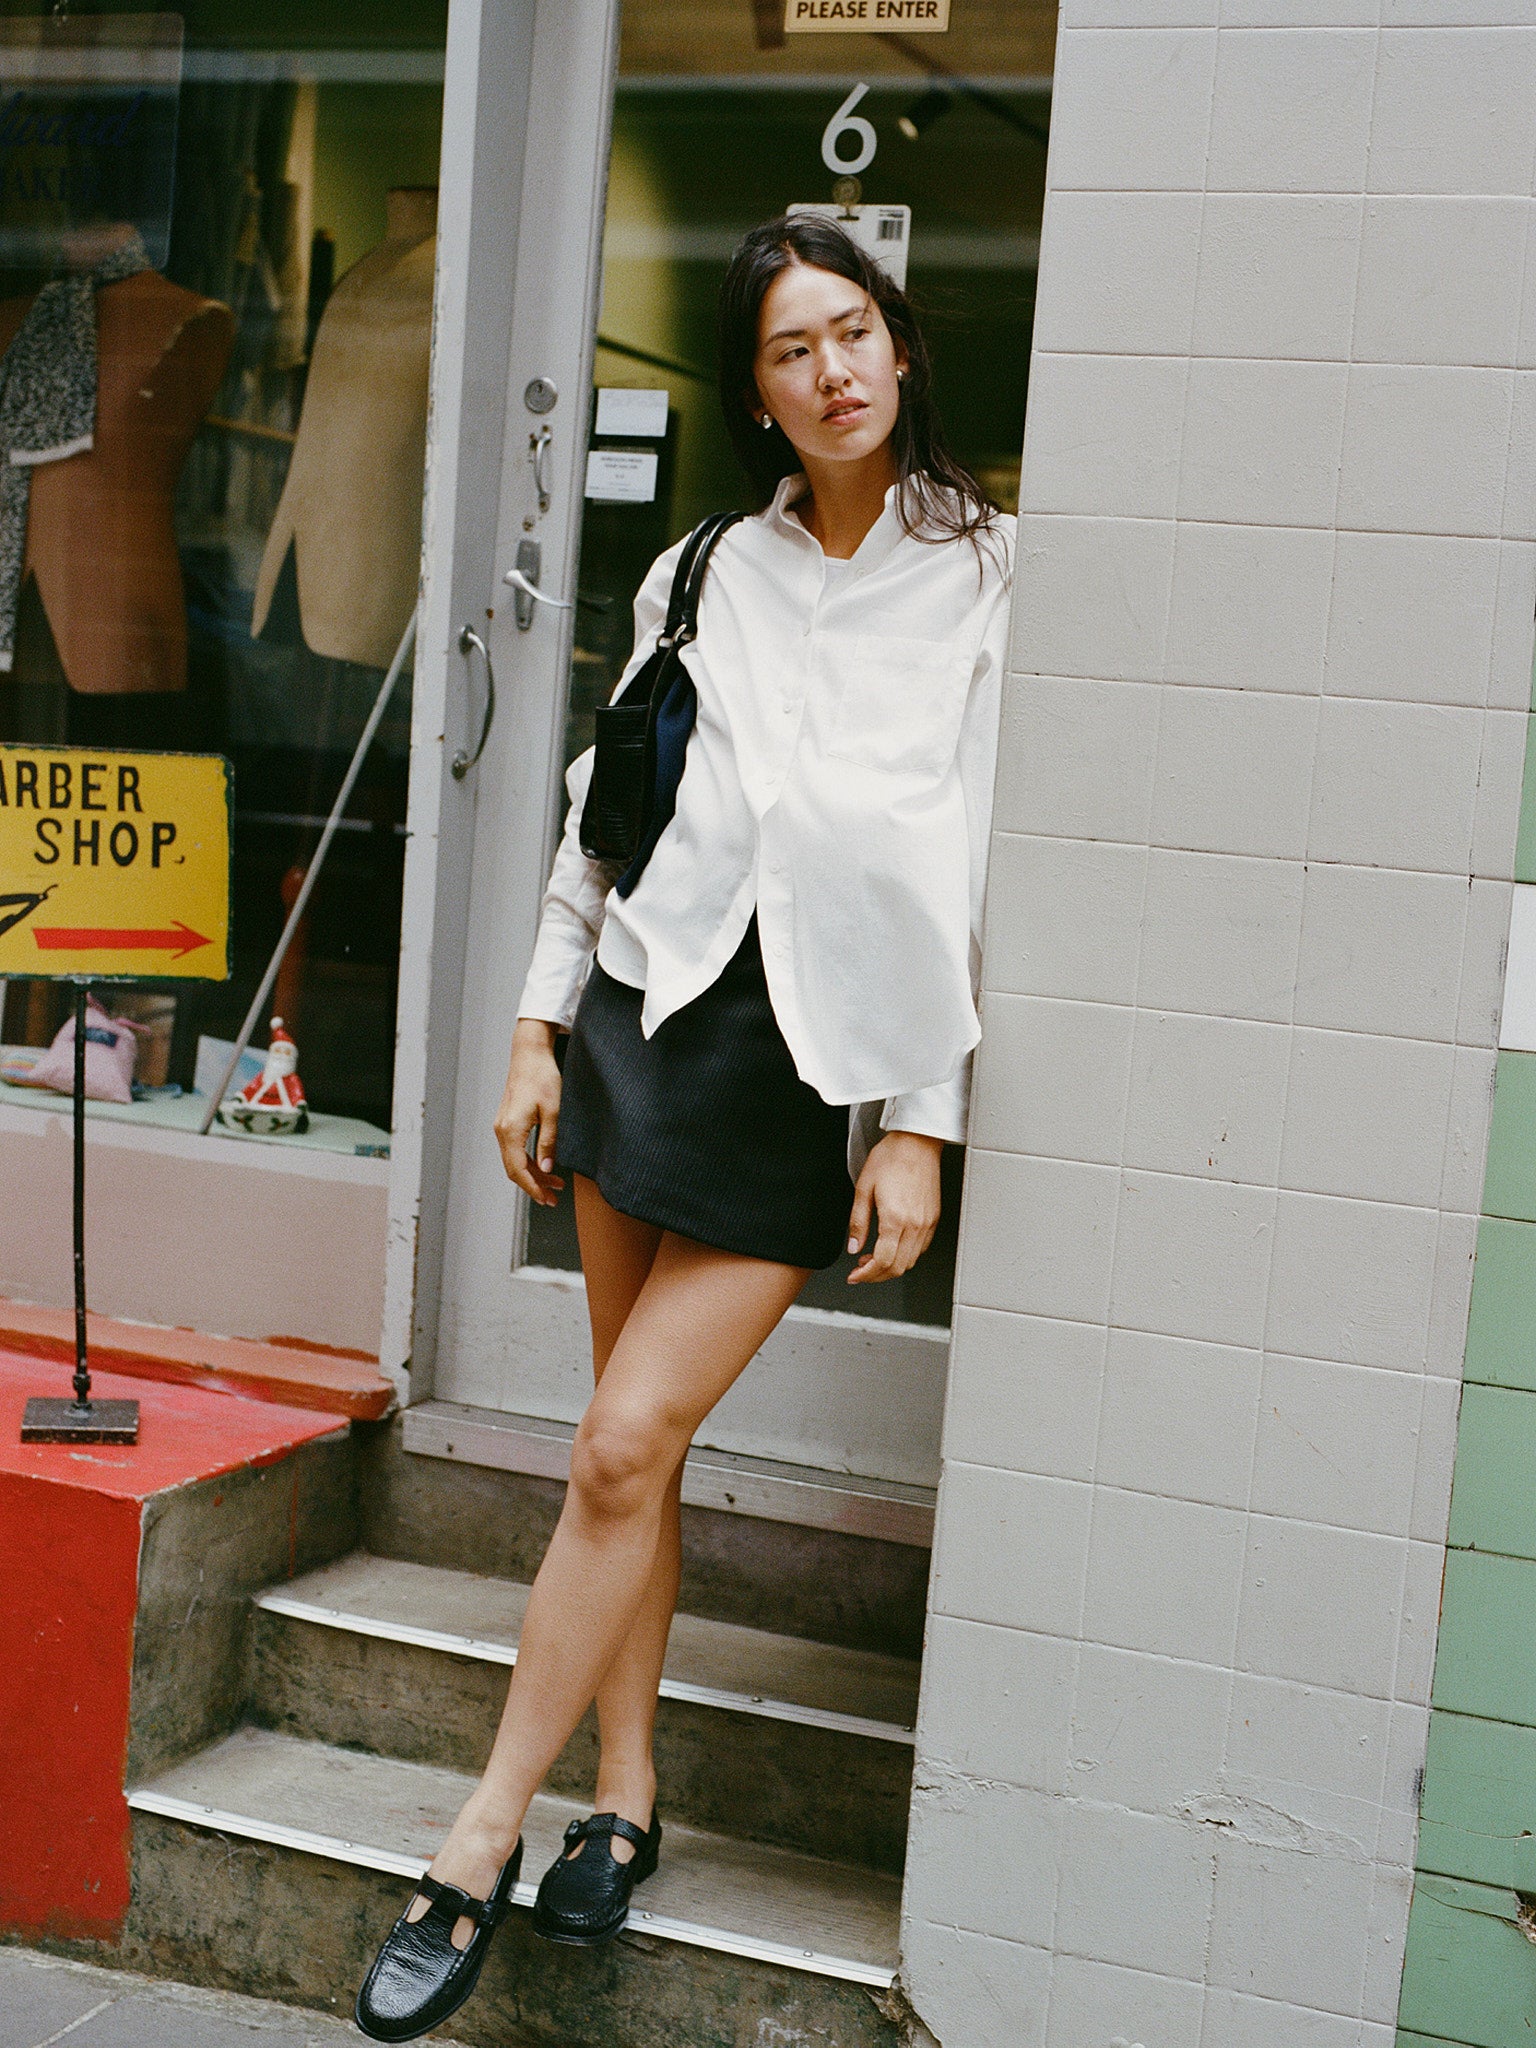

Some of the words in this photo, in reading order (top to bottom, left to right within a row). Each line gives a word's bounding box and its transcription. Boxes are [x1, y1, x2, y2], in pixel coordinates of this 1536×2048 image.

[796, 0, 868, 19] PLEASE
[876, 0, 938, 19] ENTER
[822, 81, 877, 175] 6
